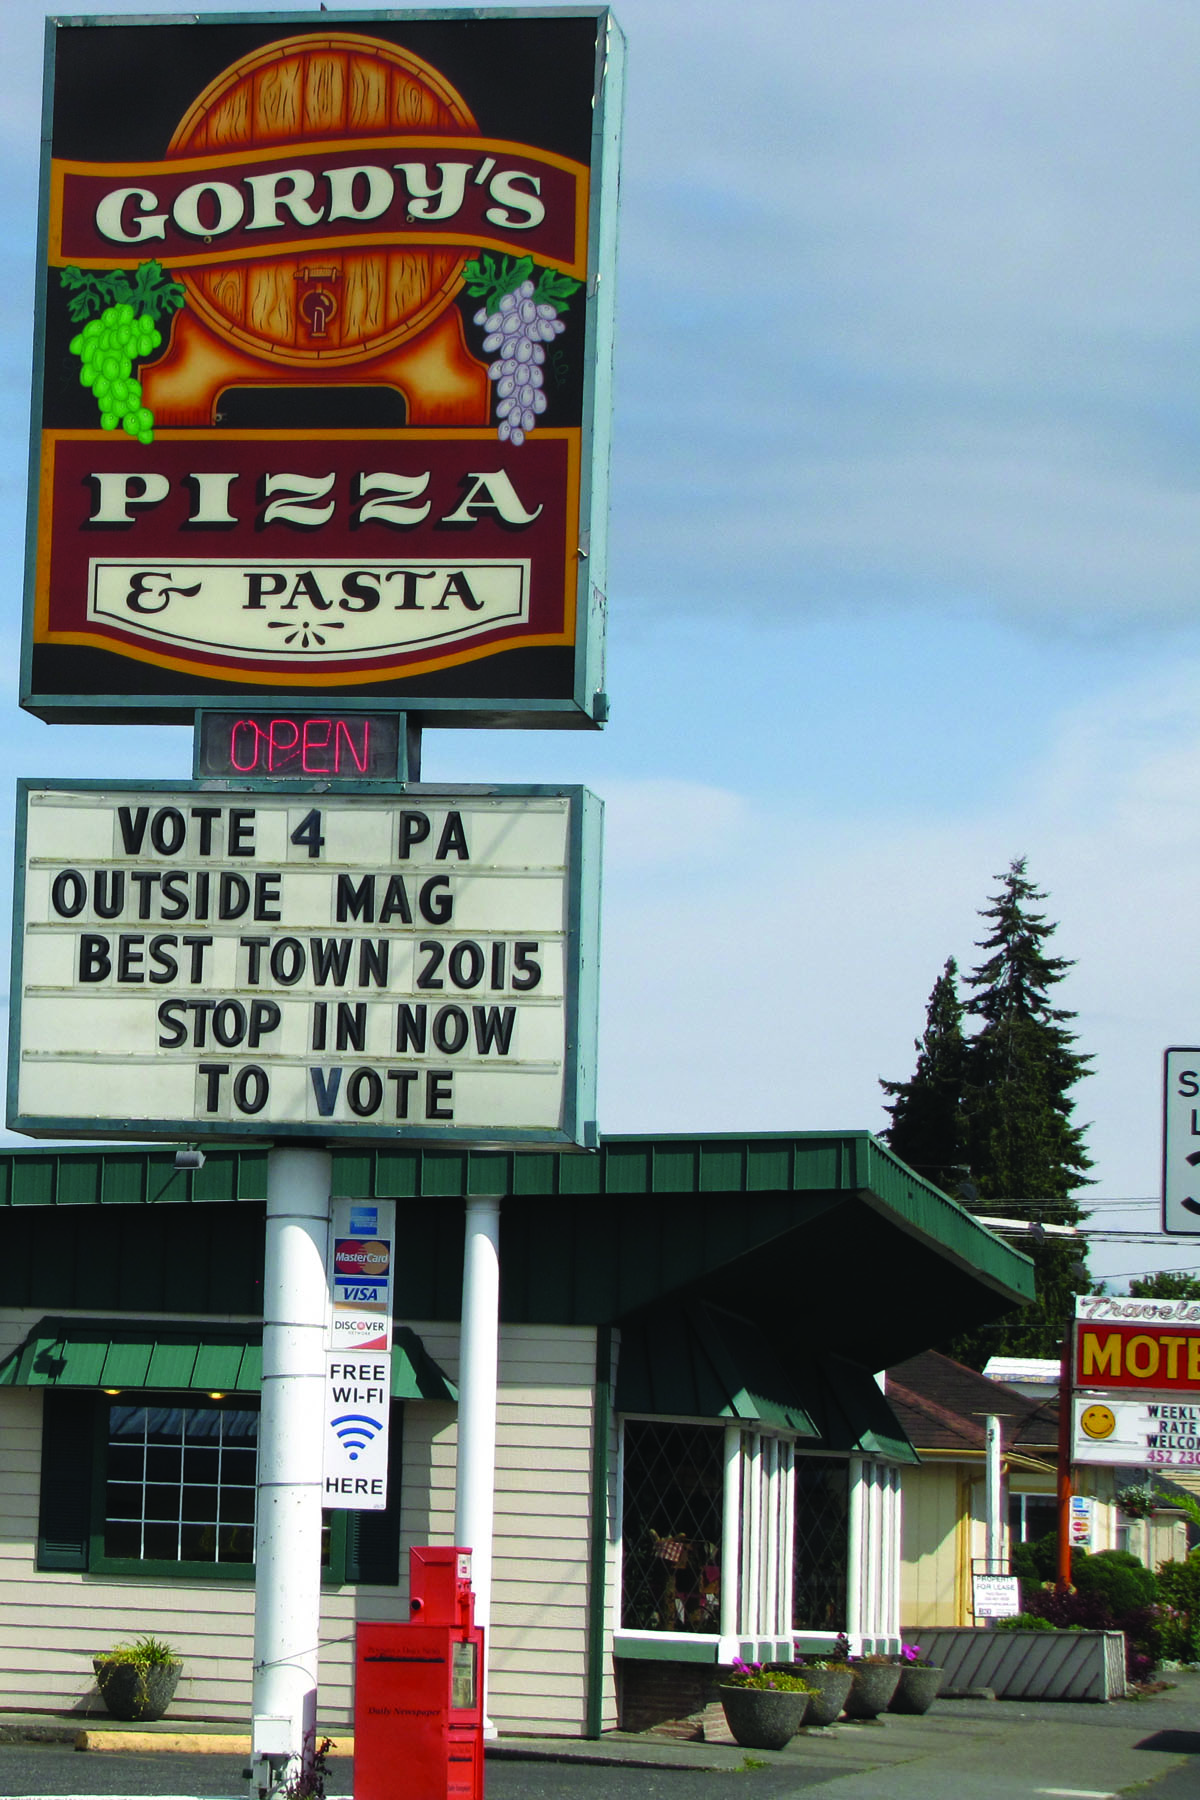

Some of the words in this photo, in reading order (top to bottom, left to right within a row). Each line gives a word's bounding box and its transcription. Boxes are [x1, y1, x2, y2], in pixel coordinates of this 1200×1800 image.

[96, 158, 546, 244] GORDY'S
[89, 468, 543, 526] PIZZA
[126, 571, 202, 613] &
[243, 570, 485, 612] PASTA
[230, 719, 369, 773] OPEN
[118, 807, 256, 856] VOTE
[290, 808, 325, 858] 4
[399, 810, 469, 861] PA
[52, 869, 282, 921] OUTSIDE
[337, 874, 453, 925] MAG
[79, 934, 212, 985] BEST
[240, 936, 390, 988] TOWN
[416, 940, 541, 991] 2015
[158, 998, 281, 1049] STOP
[312, 1001, 366, 1052] IN
[396, 1003, 517, 1056] NOW
[199, 1064, 269, 1115] TO
[310, 1067, 454, 1120] VOTE
[335, 1252, 388, 1263] MasterCard
[343, 1287, 378, 1301] VISA
[335, 1320, 385, 1331] DISCOVER
[330, 1363, 386, 1382] FREE
[332, 1386, 384, 1404] WI-FI
[1147, 1404, 1200, 1421] WEEKL
[1147, 1450, 1173, 1463] 452
[325, 1478, 384, 1496] HERE
